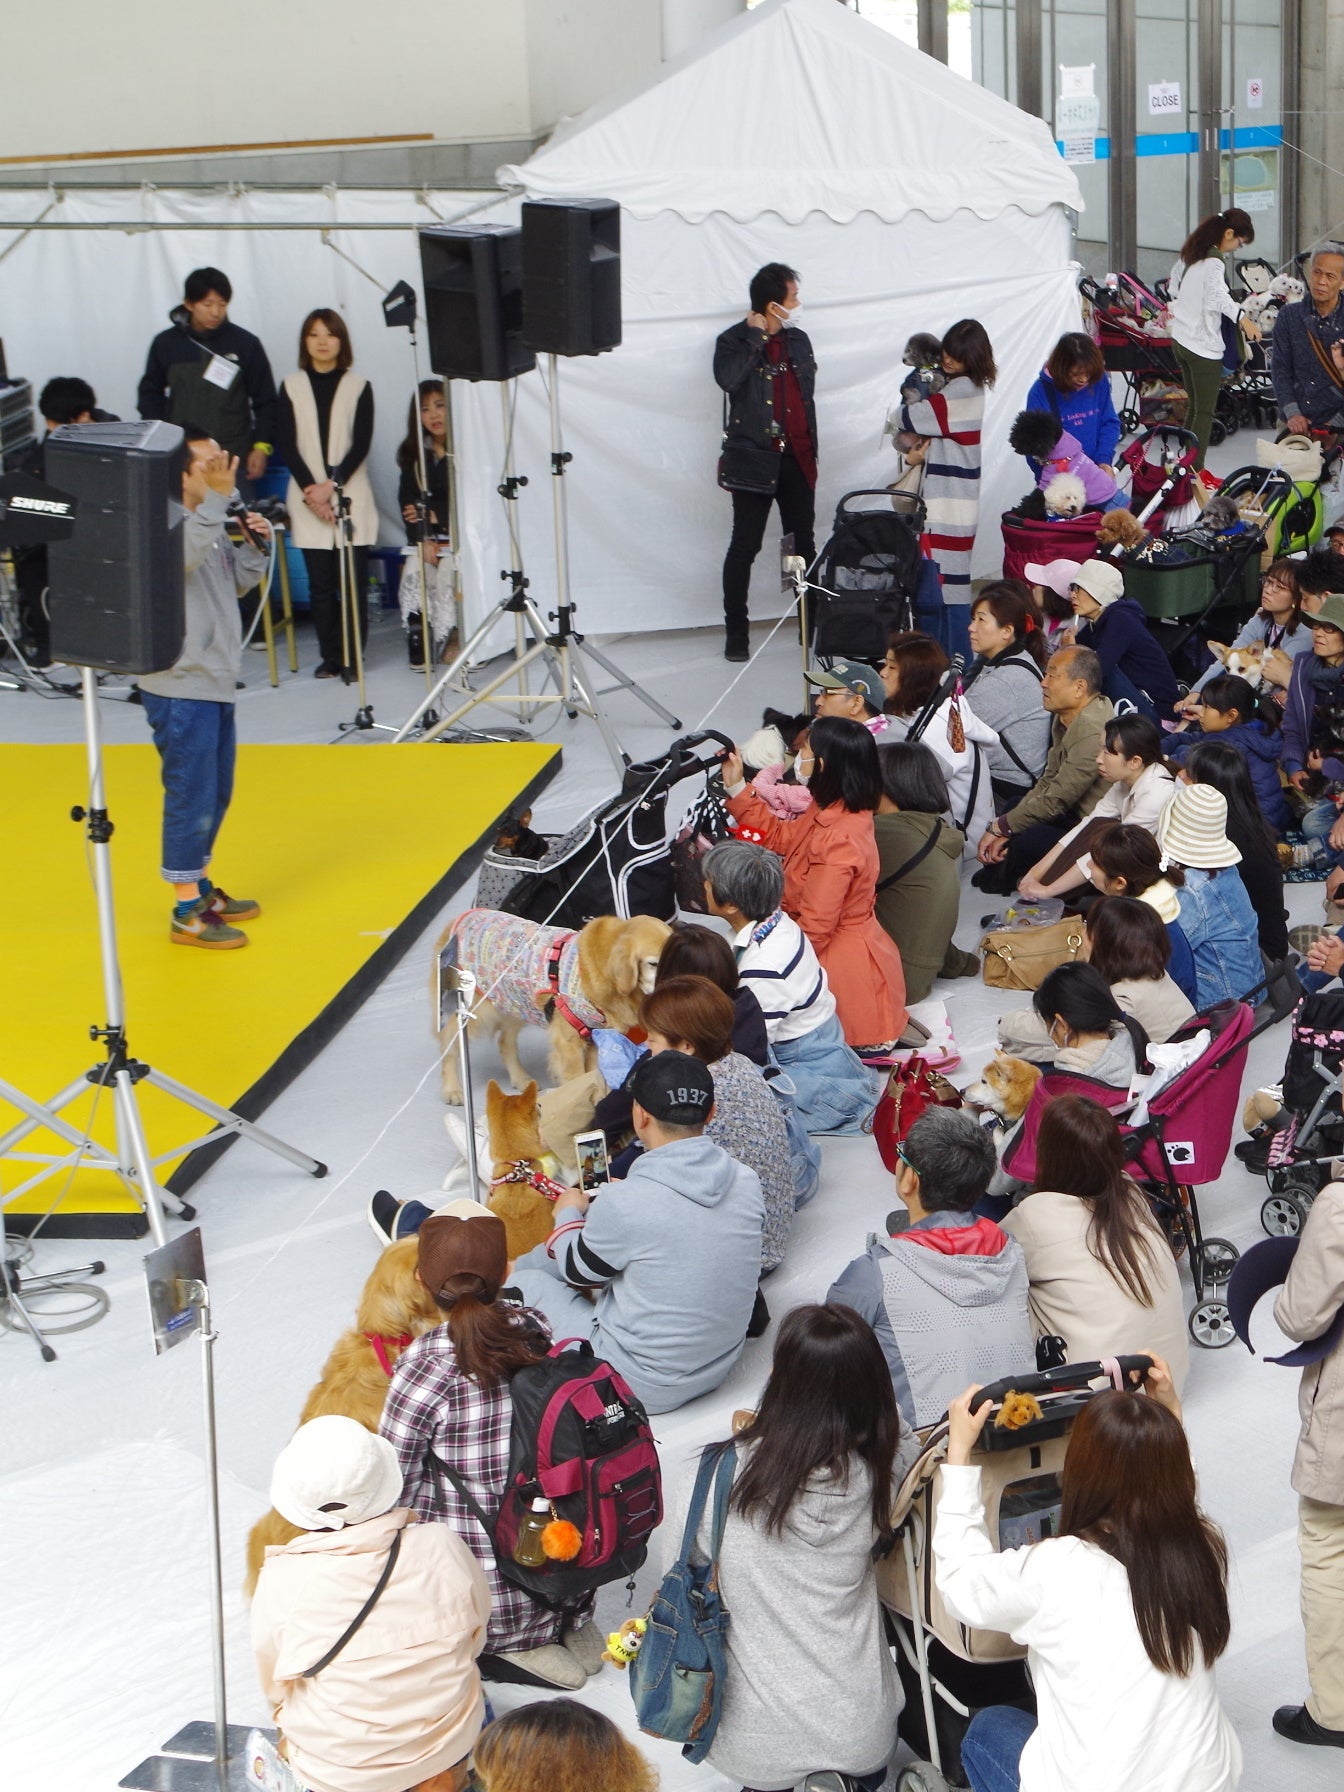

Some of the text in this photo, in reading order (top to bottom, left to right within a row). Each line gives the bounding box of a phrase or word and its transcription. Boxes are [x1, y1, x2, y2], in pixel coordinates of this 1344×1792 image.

[1151, 94, 1180, 108] CLOSE
[10, 496, 71, 514] SHURE
[666, 1087, 709, 1106] 1937
